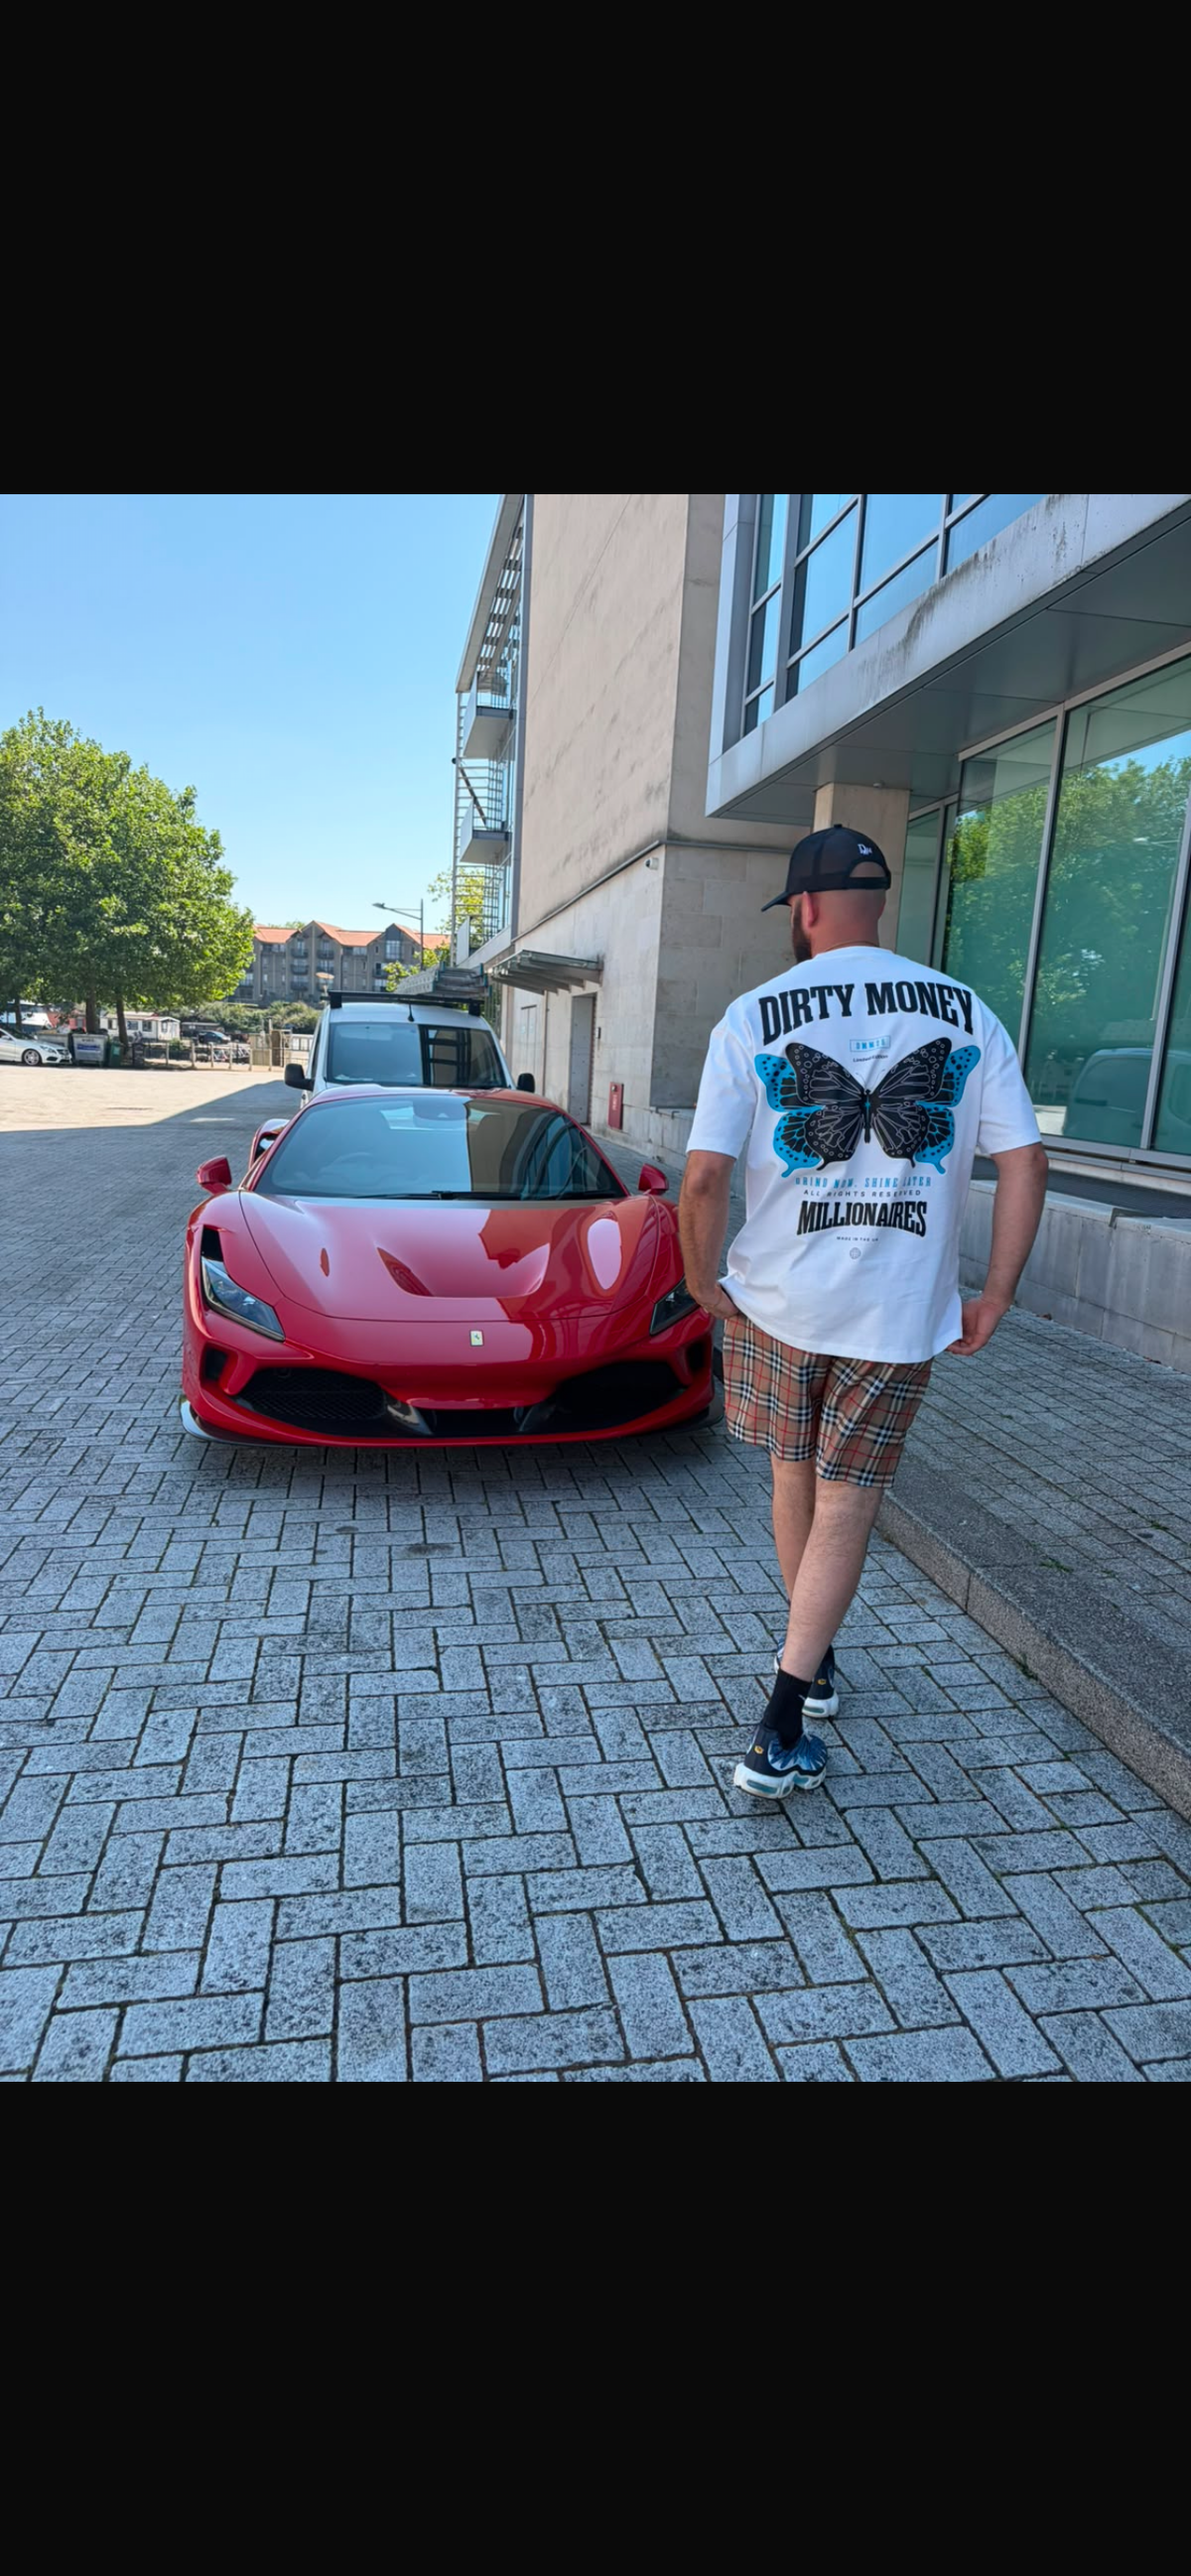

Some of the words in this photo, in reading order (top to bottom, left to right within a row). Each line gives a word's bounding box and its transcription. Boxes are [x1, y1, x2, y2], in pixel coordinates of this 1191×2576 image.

[758, 984, 855, 1046] DIRTY
[864, 980, 973, 1035] MONEY
[864, 1178, 898, 1188] SHINE
[902, 1177, 931, 1187] LATER
[796, 1201, 928, 1237] MILLIONAIRES
